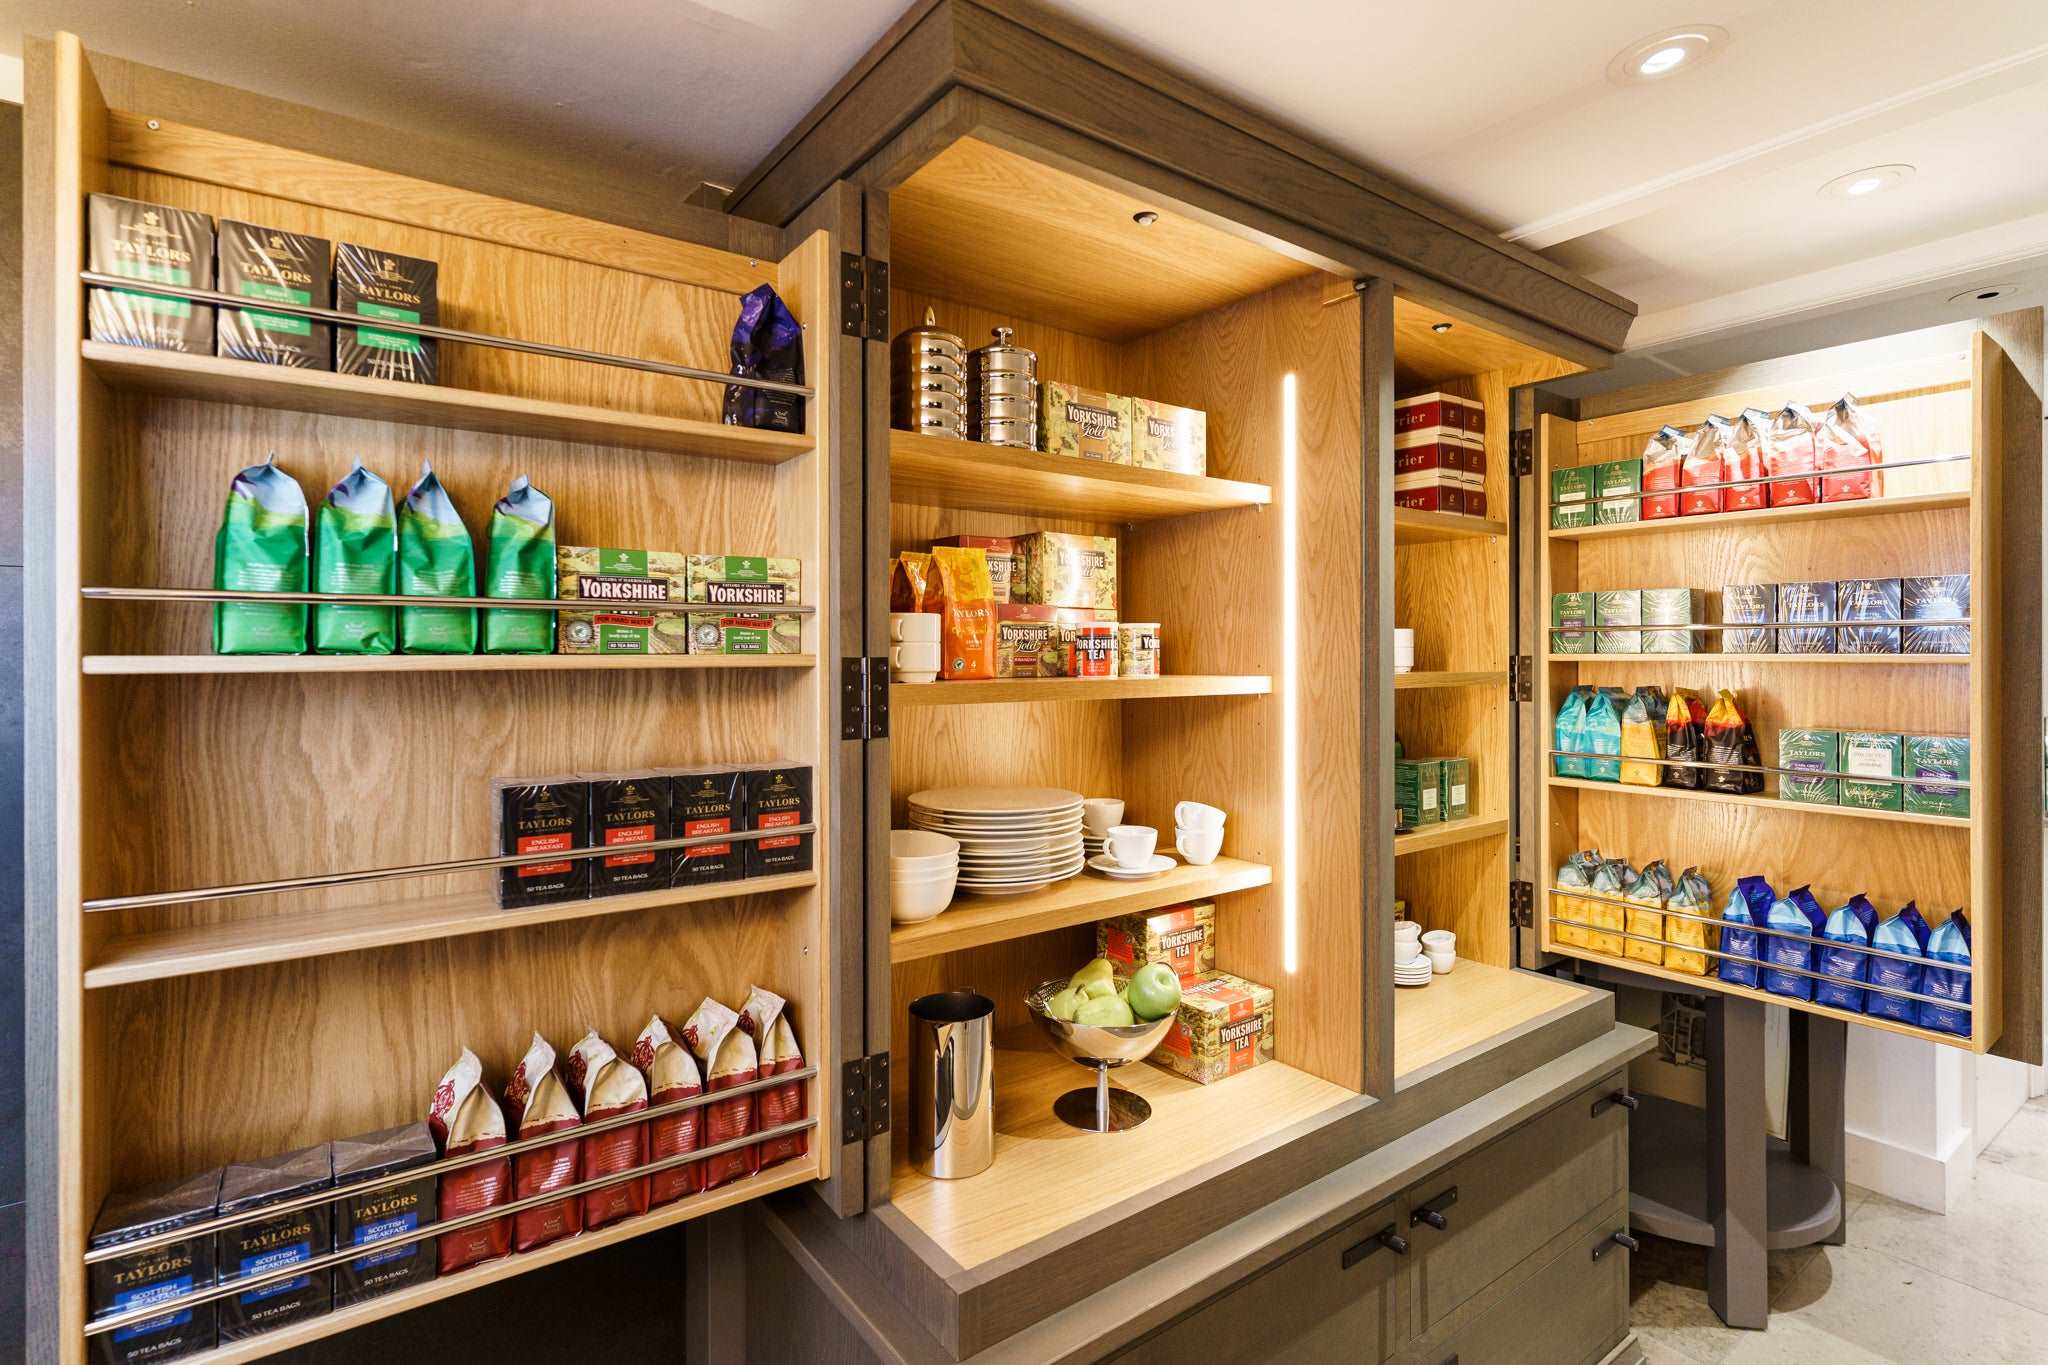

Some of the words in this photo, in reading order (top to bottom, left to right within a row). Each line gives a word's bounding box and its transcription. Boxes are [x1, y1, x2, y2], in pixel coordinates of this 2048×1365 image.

[112, 239, 191, 263] TAYLORS
[240, 262, 312, 284] TAYLORS
[1067, 404, 1117, 429] YORKSHIRE
[580, 578, 667, 600] YORKSHIRE
[708, 584, 784, 604] YORKSHIRE
[1002, 626, 1048, 640] YORKSHIRE
[1088, 649, 1105, 660] TEA
[686, 803, 731, 815] TAYLORS
[759, 797, 800, 808] TAYLORS
[519, 817, 572, 830] TAYLORS
[606, 810, 656, 822] TAYLORS
[531, 837, 559, 846] ENGLISH
[612, 835, 648, 844] BREAKFAST
[618, 829, 644, 837] ENGLISH
[526, 843, 563, 852] BREAKFAST
[1161, 928, 1203, 950] YORKSHIRE
[1176, 946, 1190, 958] TEA
[1221, 1018, 1263, 1043] YORKSHIRE
[1235, 1038, 1249, 1050] TEA
[355, 1194, 417, 1219] TAYLORS
[363, 1224, 409, 1242] BREAKFAST
[367, 1218, 406, 1234] SCOTTISH
[240, 1223, 312, 1251] TAYLORS
[250, 1255, 301, 1274] BREAKFAST
[255, 1249, 297, 1266] SCOTTISH
[113, 1255, 193, 1285] TAYLORS
[363, 1278, 374, 1287] 50
[374, 1275, 388, 1284] TEA
[389, 1268, 409, 1280] BAGS
[131, 1282, 178, 1300] SCOTTISH
[251, 1312, 262, 1320] 50
[263, 1307, 278, 1317] TEA
[280, 1301, 301, 1313] BAGS
[127, 1350, 138, 1359] 50
[140, 1345, 157, 1355] TEA
[160, 1337, 183, 1348] BAGS
